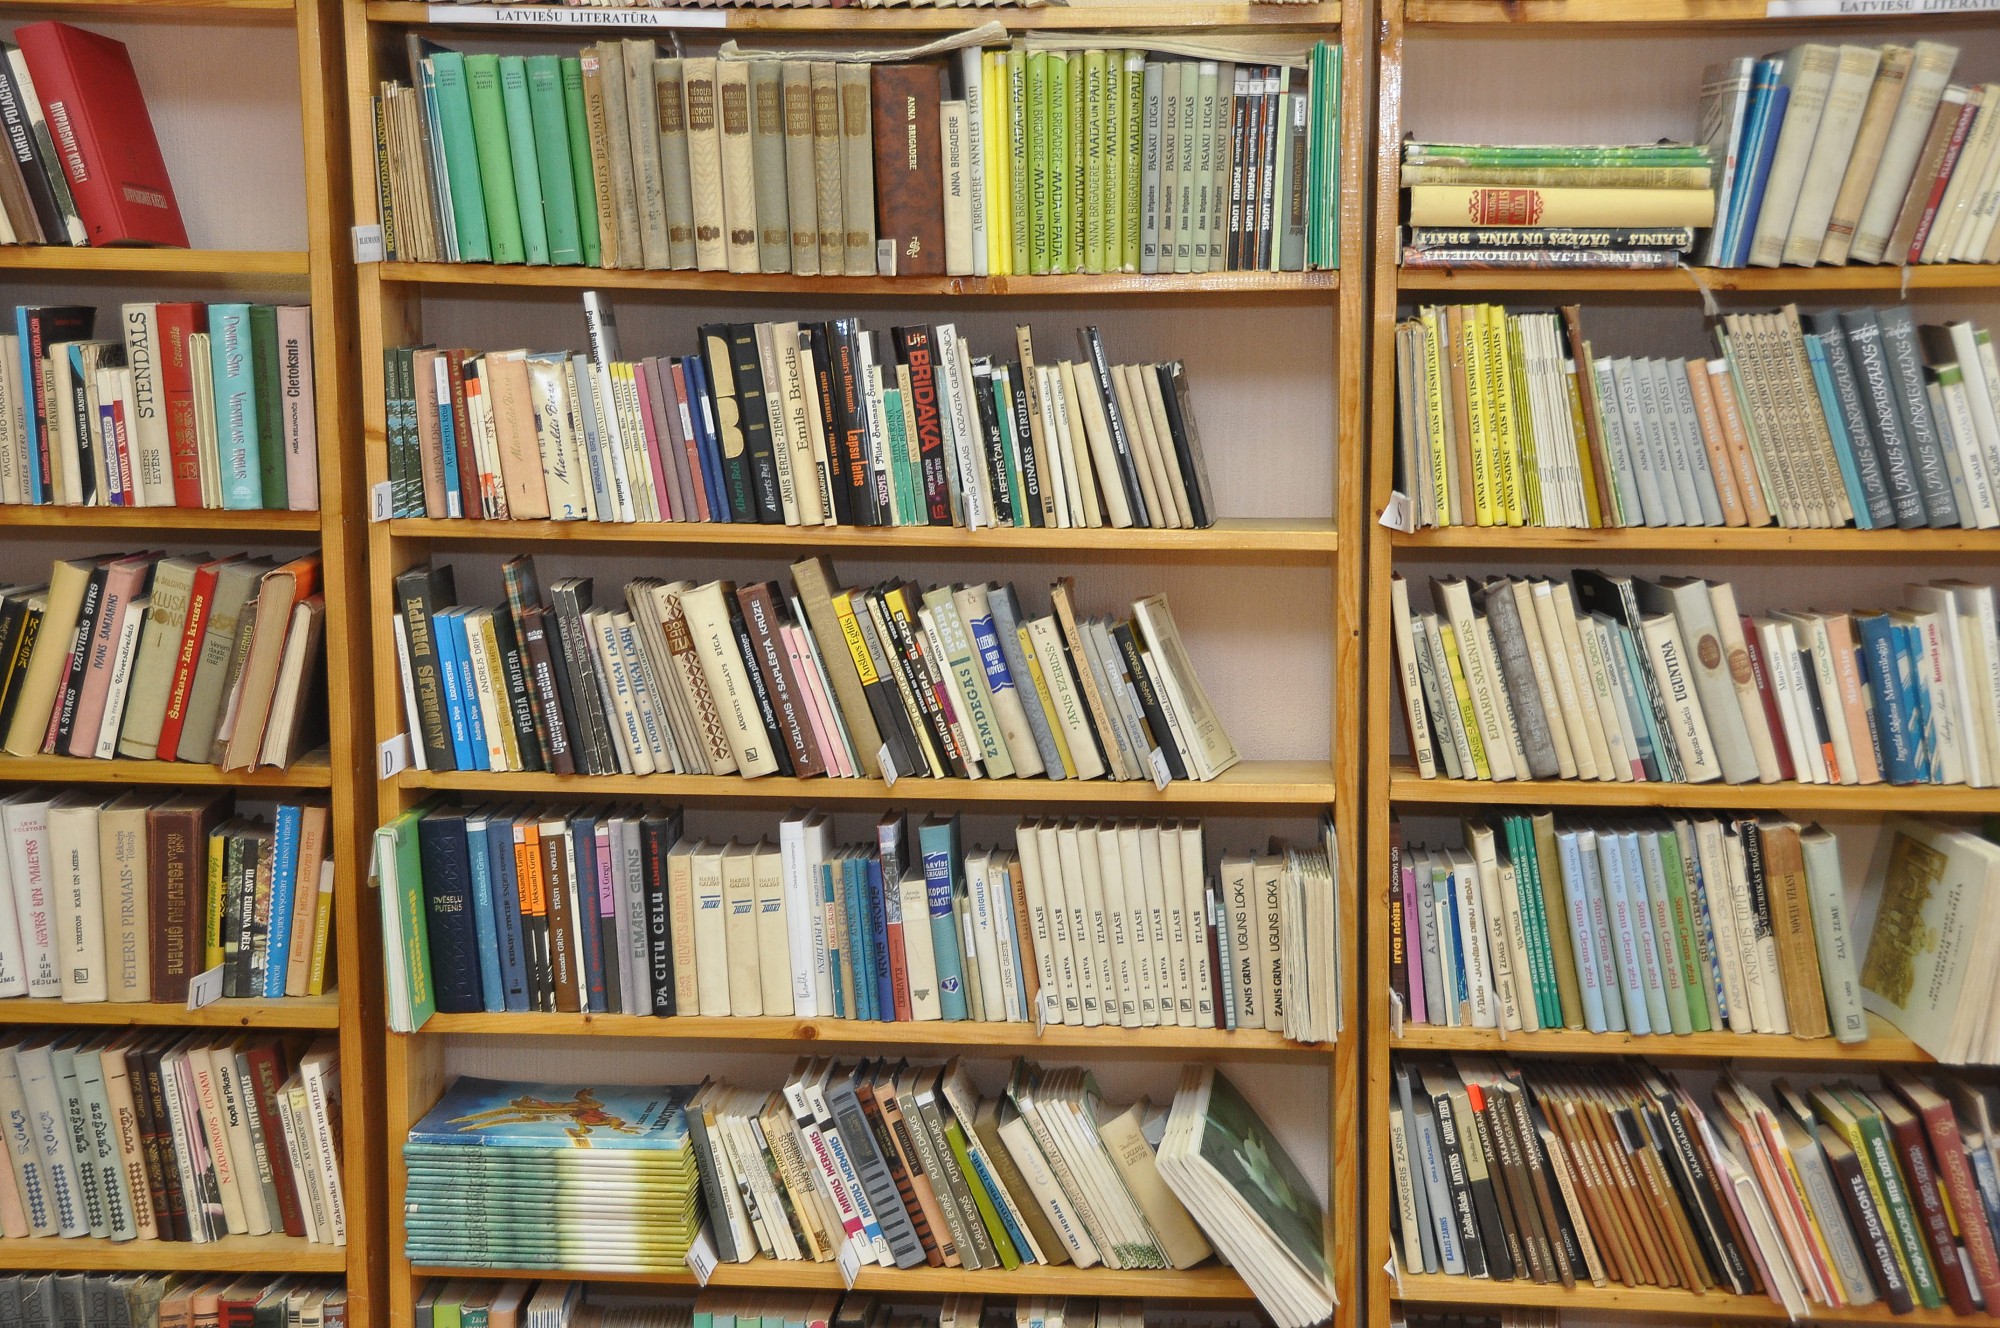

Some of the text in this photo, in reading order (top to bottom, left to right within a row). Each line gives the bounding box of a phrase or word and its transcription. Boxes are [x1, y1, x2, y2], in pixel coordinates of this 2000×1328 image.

[496, 10, 658, 24] LATVIEŠU LITERATŪRA
[1014, 70, 1023, 103] PAIJA
[49, 101, 83, 151] DIVPADSMIT
[377, 102, 387, 144] NOVELES
[1149, 96, 1158, 128] LUGAS
[10, 125, 33, 162] KARELS
[971, 122, 980, 166] ANNELES
[1015, 119, 1025, 158] MAIJA
[1148, 134, 1157, 171] PASAKU
[380, 150, 391, 206] BLAUMANIS
[1015, 166, 1025, 216] BRIGADERE
[972, 176, 982, 222] BRIGADERE
[1147, 185, 1156, 213] Brigadere
[1016, 221, 1026, 247] ANNA
[1527, 232, 1545, 244] UN
[1627, 232, 1689, 246] RAINIS
[128, 312, 156, 419] STENDĀLS
[285, 339, 301, 398] Cietoksnis
[785, 347, 801, 401] Briedis
[909, 349, 941, 452] BRIDAKA
[1831, 346, 1871, 447] SUDRABKALNS
[549, 419, 569, 484] Miervaldis
[847, 430, 868, 486] Lapsu laiks
[1016, 391, 1039, 495] GUNĀRS CĪRULIS
[992, 426, 1010, 503] ALBERTS CAUNE
[1433, 448, 1442, 481] SAKSE
[1767, 454, 1788, 500] SUDRABU
[781, 479, 794, 503] JĀNIS
[751, 599, 768, 635] KRŪZE
[896, 612, 918, 660] SLAZDS
[93, 645, 108, 669] IVANS
[168, 668, 190, 720] Šankars
[187, 594, 204, 637] krusts
[604, 626, 618, 656] LABU
[851, 646, 871, 677] Anšlavs
[407, 596, 445, 749] ANDREJS DRIPE
[612, 662, 627, 695] TIKAI
[712, 633, 747, 730] AUGUSTS DEGLAVS RĪGA
[764, 638, 787, 691] SAPLĒSTĀ
[1125, 642, 1154, 706] AIVARS FREIMANIS
[1461, 619, 1500, 740] EDUARDS SALENIEKS
[508, 650, 533, 733] PĒDĒJĀ BARJERA
[918, 671, 939, 712] EZERA
[1883, 673, 1896, 700] Mana
[783, 702, 805, 749] DZIĻUMS
[960, 668, 998, 757] ZEMDEGAS
[549, 841, 558, 871] NOVELES
[1232, 879, 1245, 908] LOKĀ
[118, 870, 137, 989] PĒTERIS PIRMAIS
[629, 901, 645, 958] ELMĀRS
[1036, 906, 1047, 939] IZLASE
[1235, 912, 1249, 951] UGUNS
[1831, 906, 1841, 931] ZEME
[558, 953, 567, 984] Aleksandrs
[654, 940, 666, 980] CITU
[1241, 957, 1251, 985] GRĪVA
[220, 1066, 234, 1095] Pikaso
[227, 1105, 239, 1127] Kopā
[1438, 1099, 1449, 1119] ZIEDI
[210, 1116, 230, 1174] ZADORNOVS
[1486, 1096, 1511, 1165] SĀKAMGRĀMATA
[921, 1147, 939, 1179] PUTRAS
[1448, 1153, 1464, 1185] LIKTENIS
[328, 1180, 343, 1225] Zakovskis
[829, 1178, 852, 1214] ANATOLS
[1049, 1198, 1081, 1251] ILZE INDRĀNE
[1851, 1174, 1901, 1289] DAGNIJA ZIGMONTE
